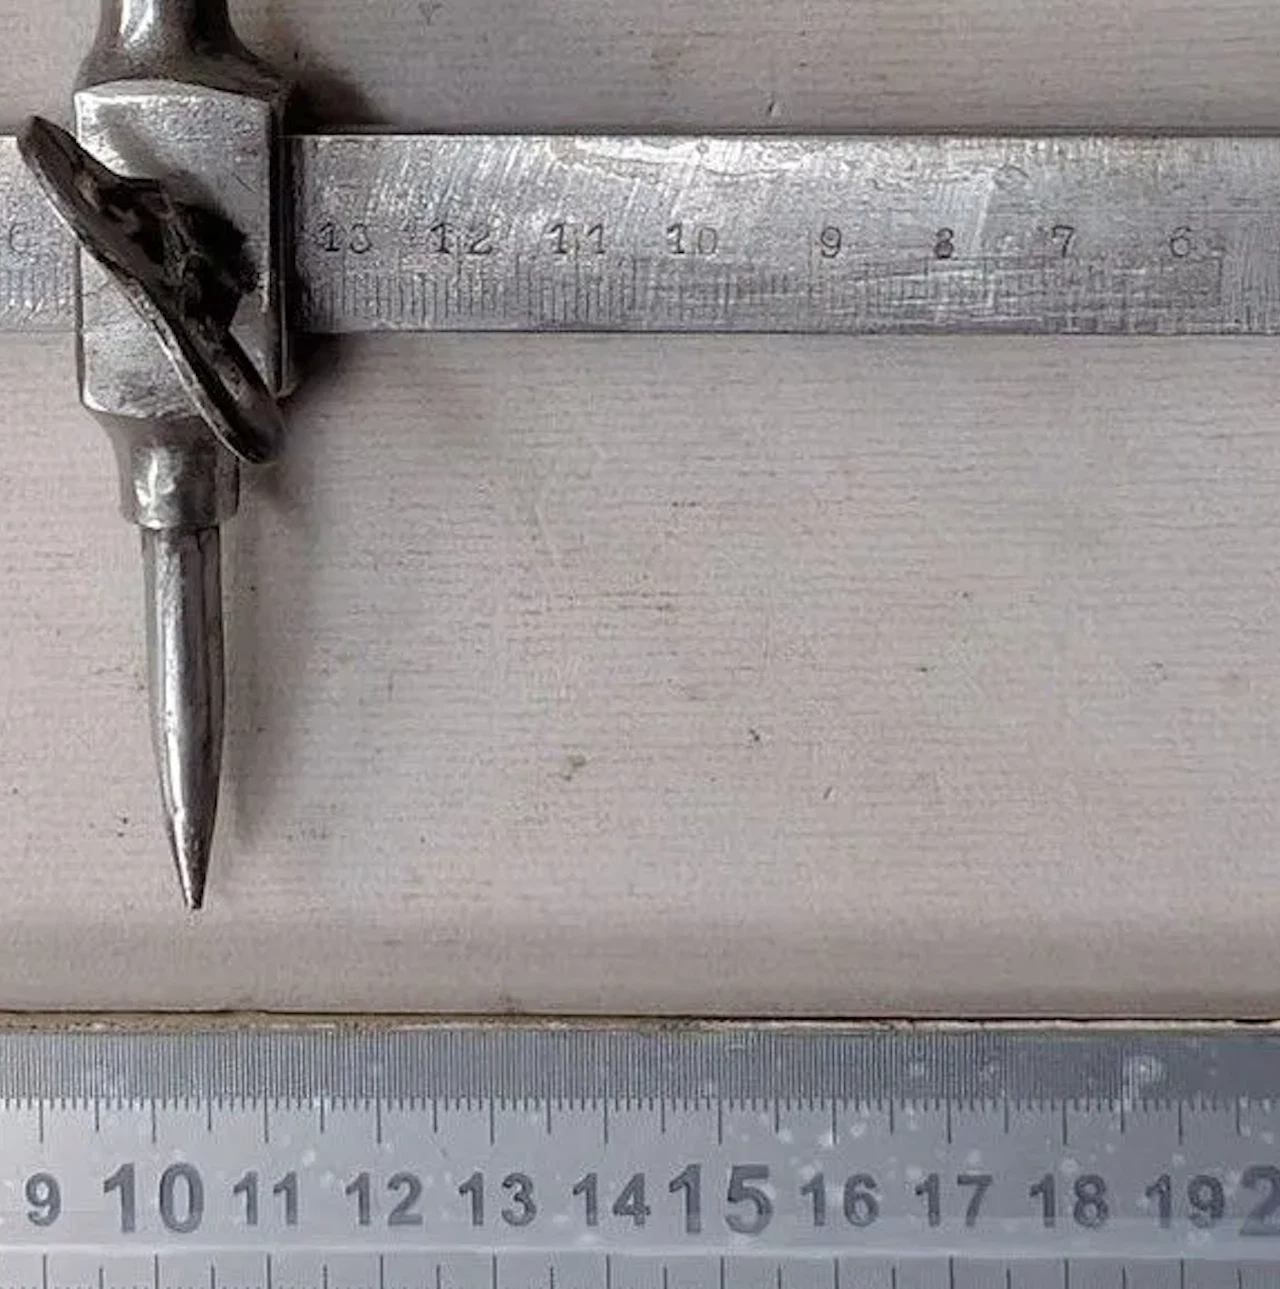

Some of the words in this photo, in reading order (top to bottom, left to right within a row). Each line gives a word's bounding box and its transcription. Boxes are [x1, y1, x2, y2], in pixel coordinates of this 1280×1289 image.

[430, 221, 495, 255] 12
[550, 222, 606, 255] 11
[668, 224, 718, 256] 10
[818, 227, 843, 259] 9
[1051, 225, 1077, 257] 7
[1170, 226, 1193, 258] 6
[25, 1172, 61, 1226] 9
[103, 1162, 204, 1235] 10
[233, 1171, 300, 1225] 11
[345, 1172, 422, 1227] 12
[458, 1172, 537, 1228] 13
[572, 1173, 650, 1227] 14
[668, 1164, 772, 1235] 15
[800, 1174, 879, 1227] 16
[915, 1174, 993, 1226] 17
[1029, 1173, 1108, 1228] 18
[1145, 1174, 1225, 1229] 19
